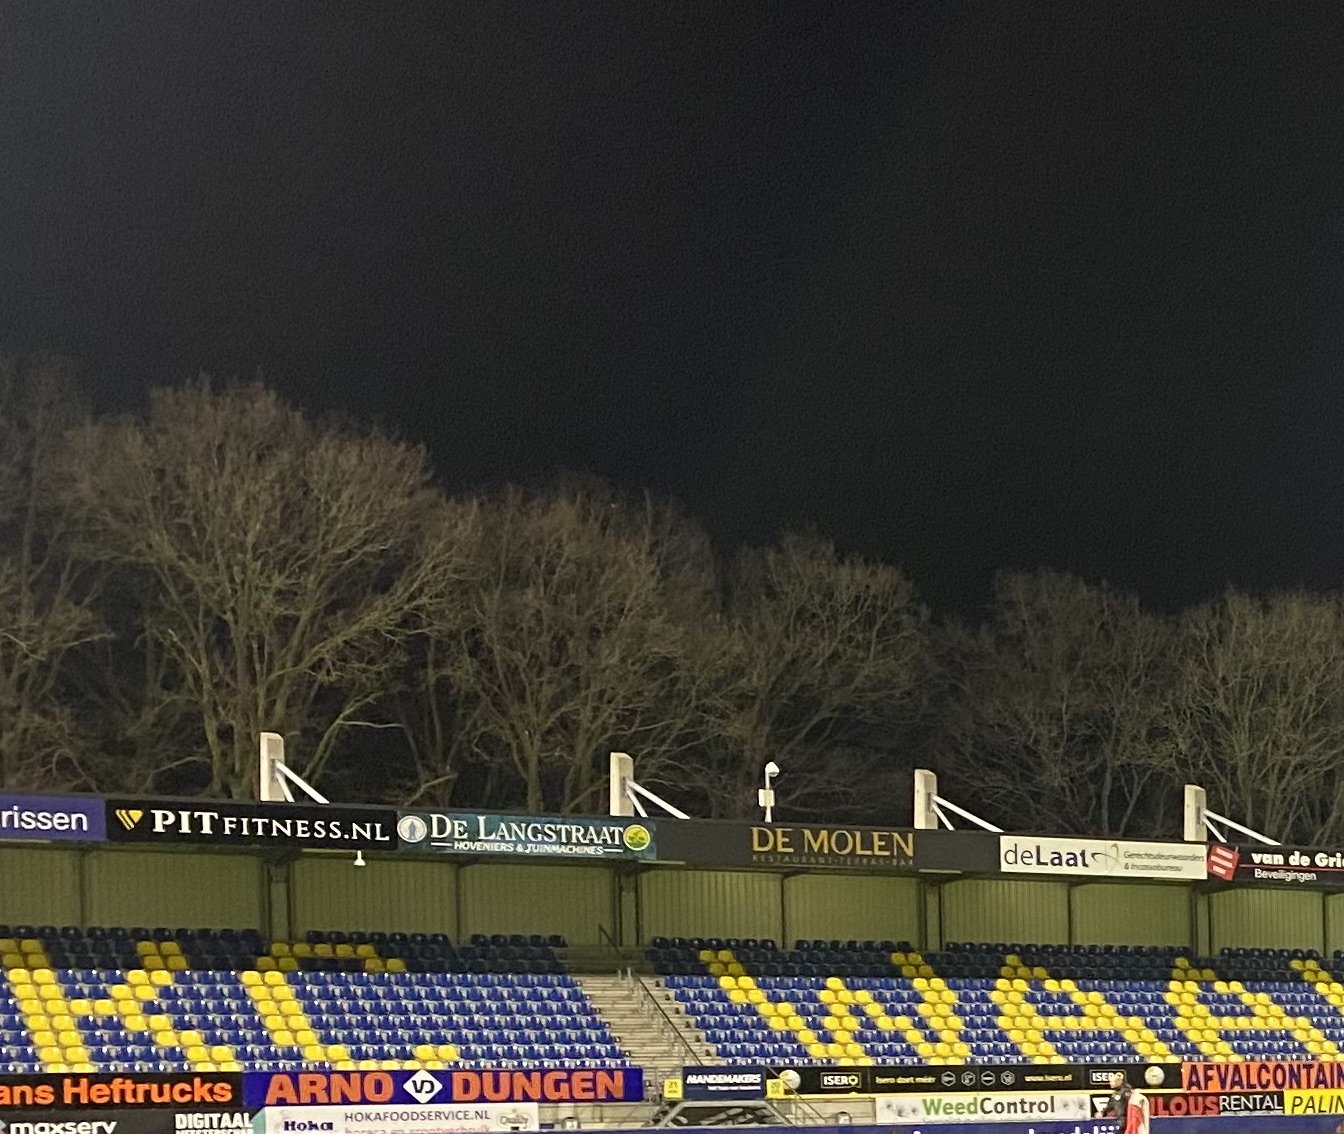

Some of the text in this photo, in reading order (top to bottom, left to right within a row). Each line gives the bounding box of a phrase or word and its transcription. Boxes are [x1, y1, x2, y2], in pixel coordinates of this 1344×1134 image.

[430, 813, 624, 845] DE LANGSTRAAT
[454, 840, 516, 852] HOVENIERS
[524, 842, 604, 855] TUINMACHINES
[750, 827, 914, 857] DE MOLEN
[1251, 852, 1284, 865] van
[1288, 851, 1311, 867] de
[265, 1072, 395, 1105] ARNO
[452, 1071, 624, 1102] DUNGEN
[686, 1073, 762, 1085] MANDEMAKERS
[823, 1075, 860, 1086] ISERO
[63, 1076, 234, 1105] Heftrucks
[922, 1096, 1055, 1116] WeedControl
[1220, 1093, 1284, 1112] RENTAL
[175, 1112, 254, 1130] DIGITAAL
[344, 1110, 490, 1123] HOKAFOODSERVICE.NL
